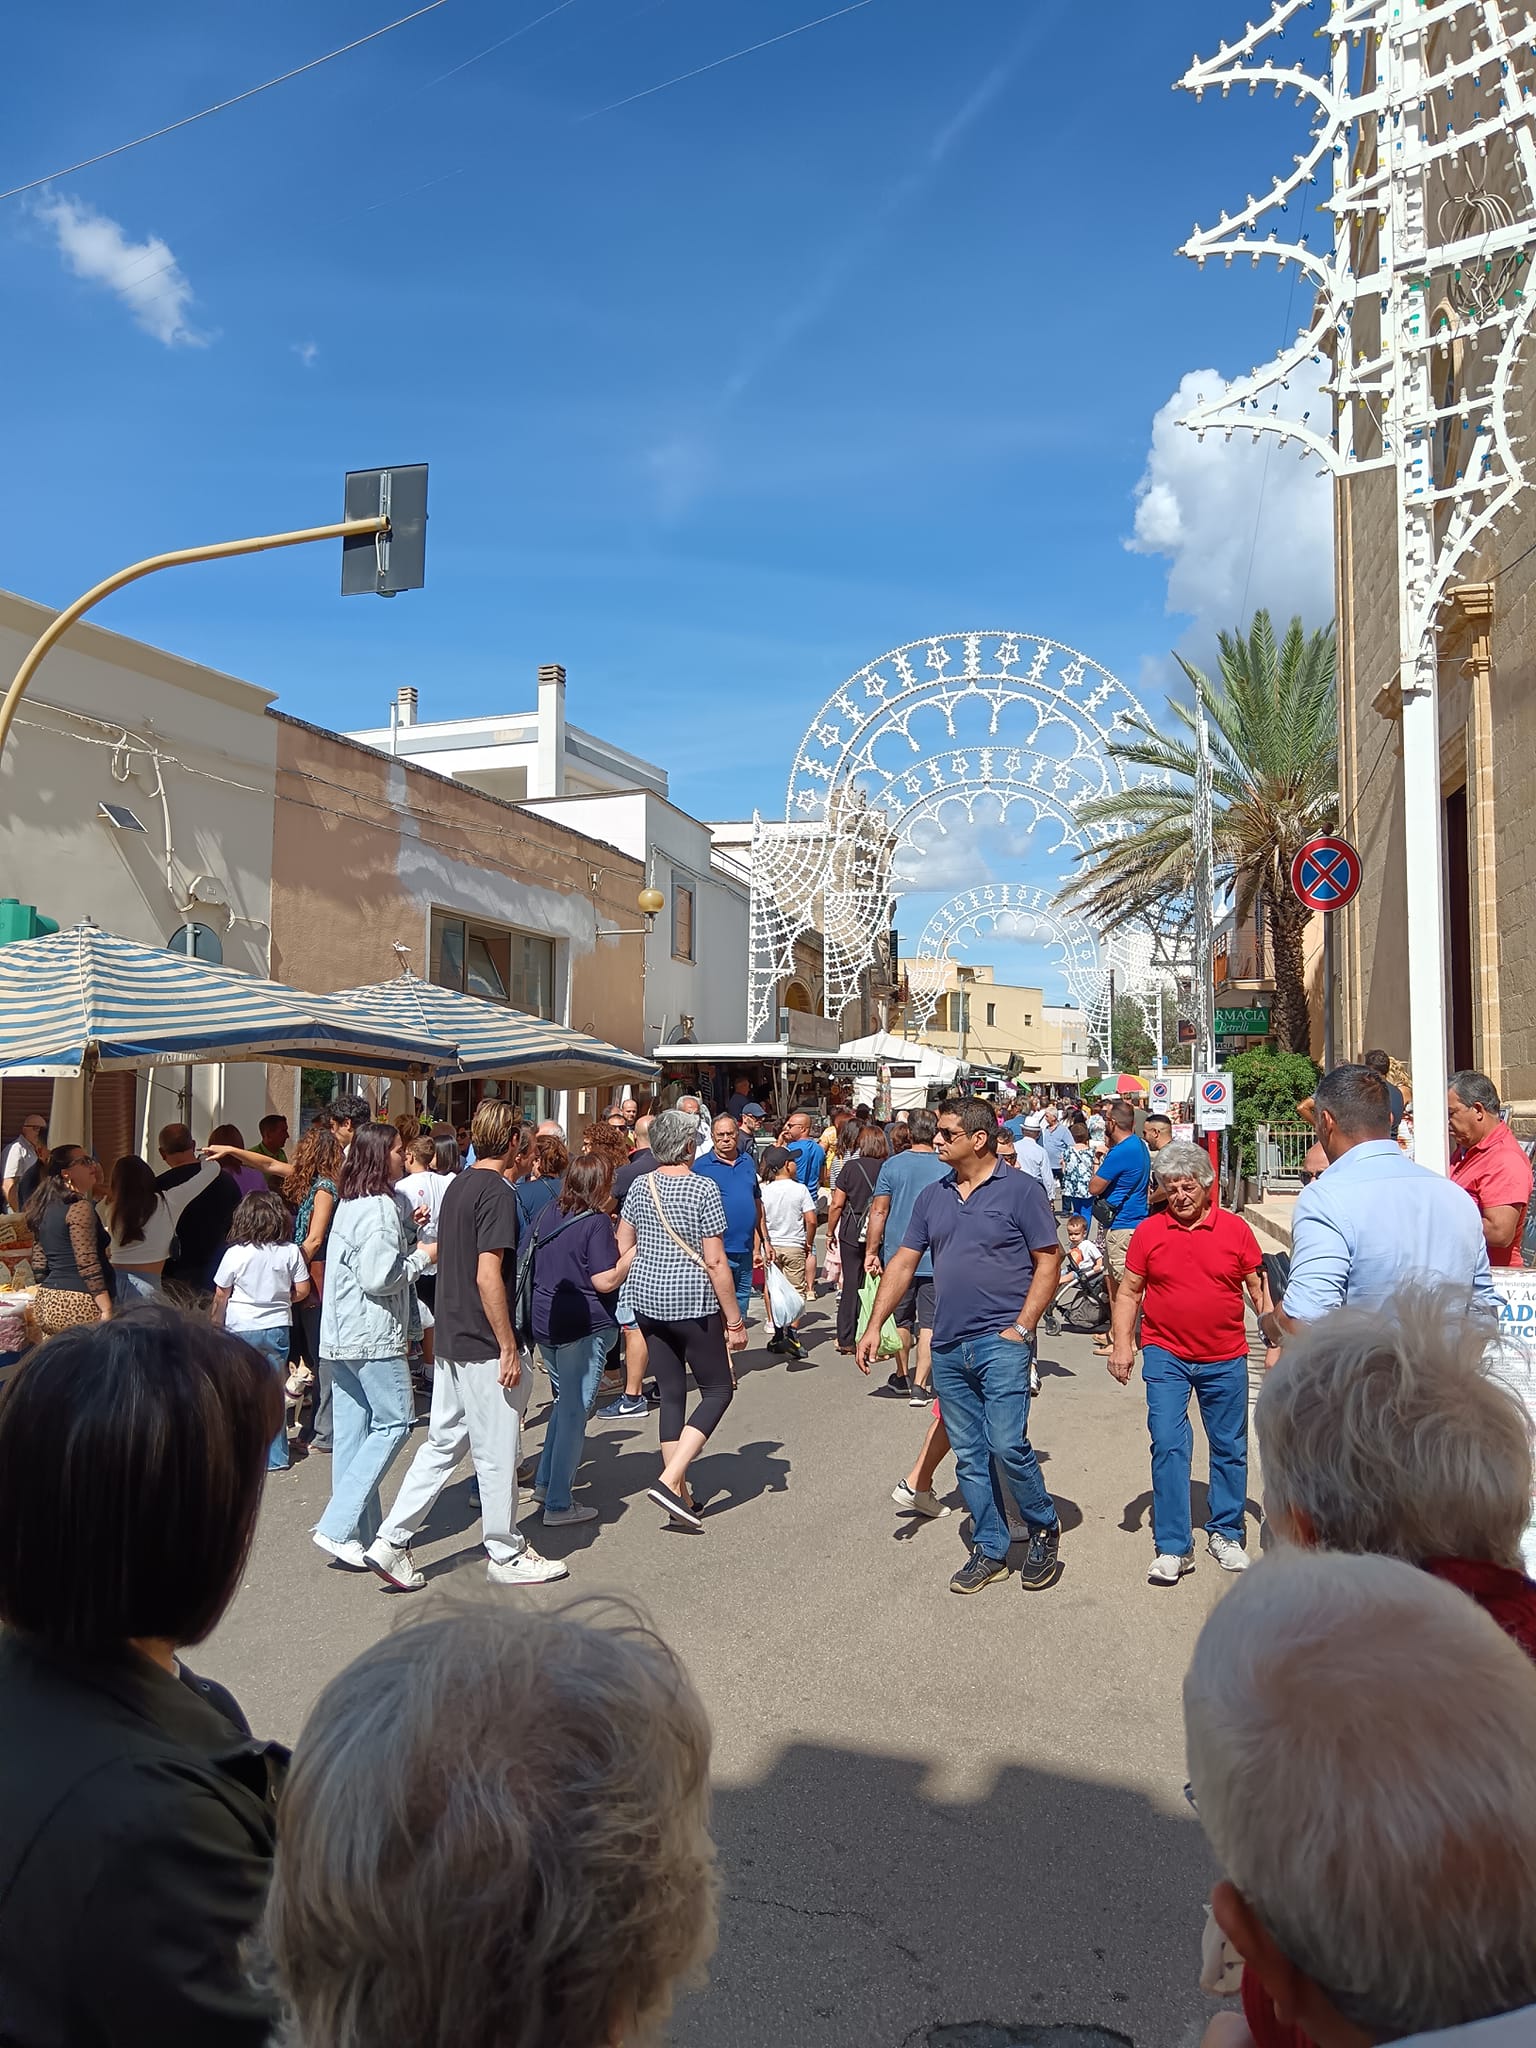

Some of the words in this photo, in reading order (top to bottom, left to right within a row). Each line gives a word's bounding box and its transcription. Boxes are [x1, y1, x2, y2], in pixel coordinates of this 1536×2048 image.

[1216, 1009, 1266, 1020] RMACIA
[1219, 1021, 1249, 1032] Petrelli
[833, 1062, 877, 1072] DOLCIUMI
[1504, 1280, 1536, 1289] festeggia
[1506, 1290, 1517, 1301] V.
[1499, 1304, 1536, 1322] AD
[1499, 1323, 1536, 1338] LUC
